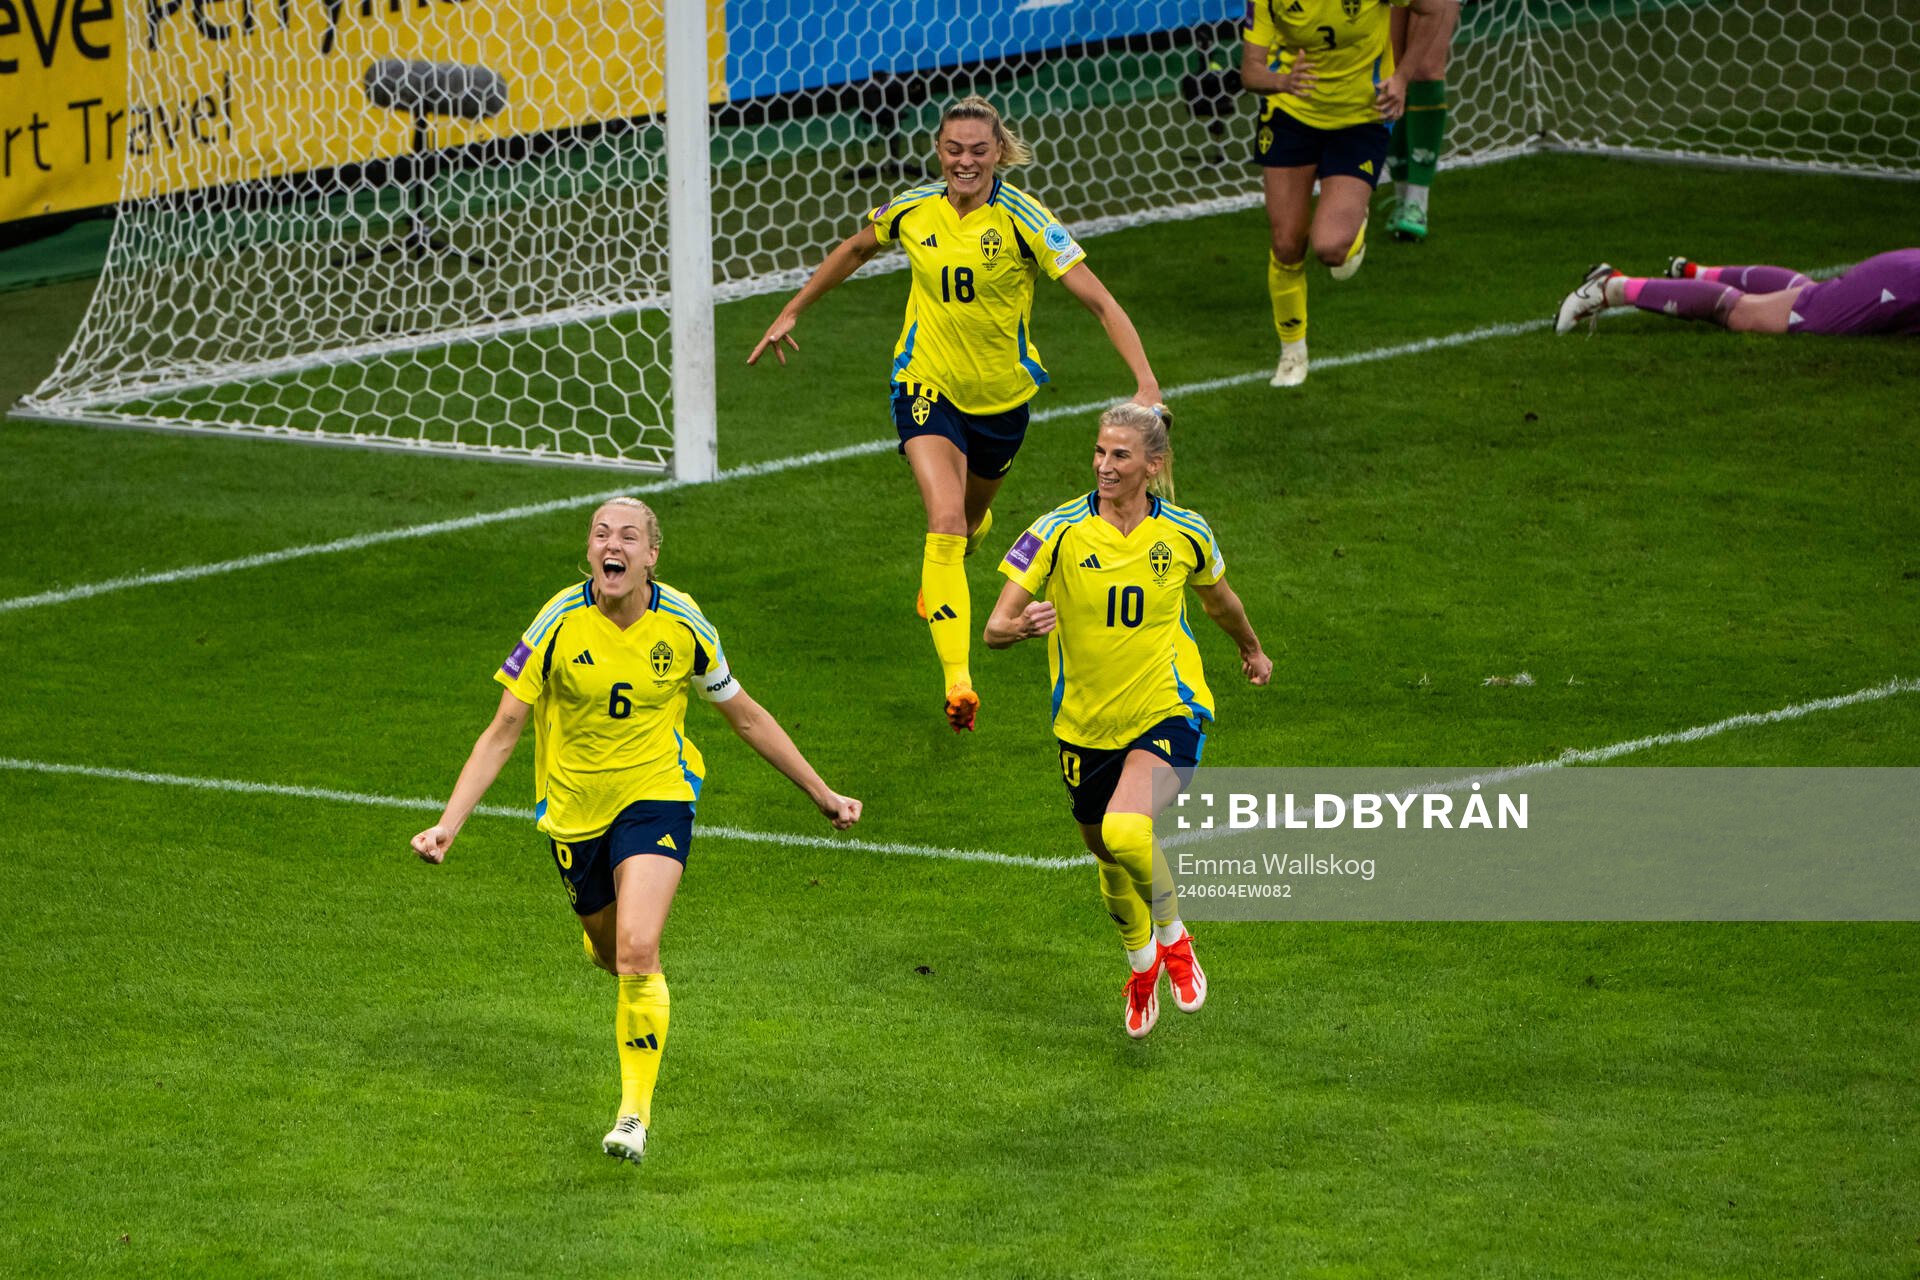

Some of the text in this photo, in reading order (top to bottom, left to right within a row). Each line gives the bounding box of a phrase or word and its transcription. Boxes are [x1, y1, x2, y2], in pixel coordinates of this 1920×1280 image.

[1317, 25, 1337, 51] 3
[67, 70, 232, 165] Travel
[941, 265, 976, 304] 18
[1106, 585, 1145, 628] 10
[608, 682, 633, 720] 6
